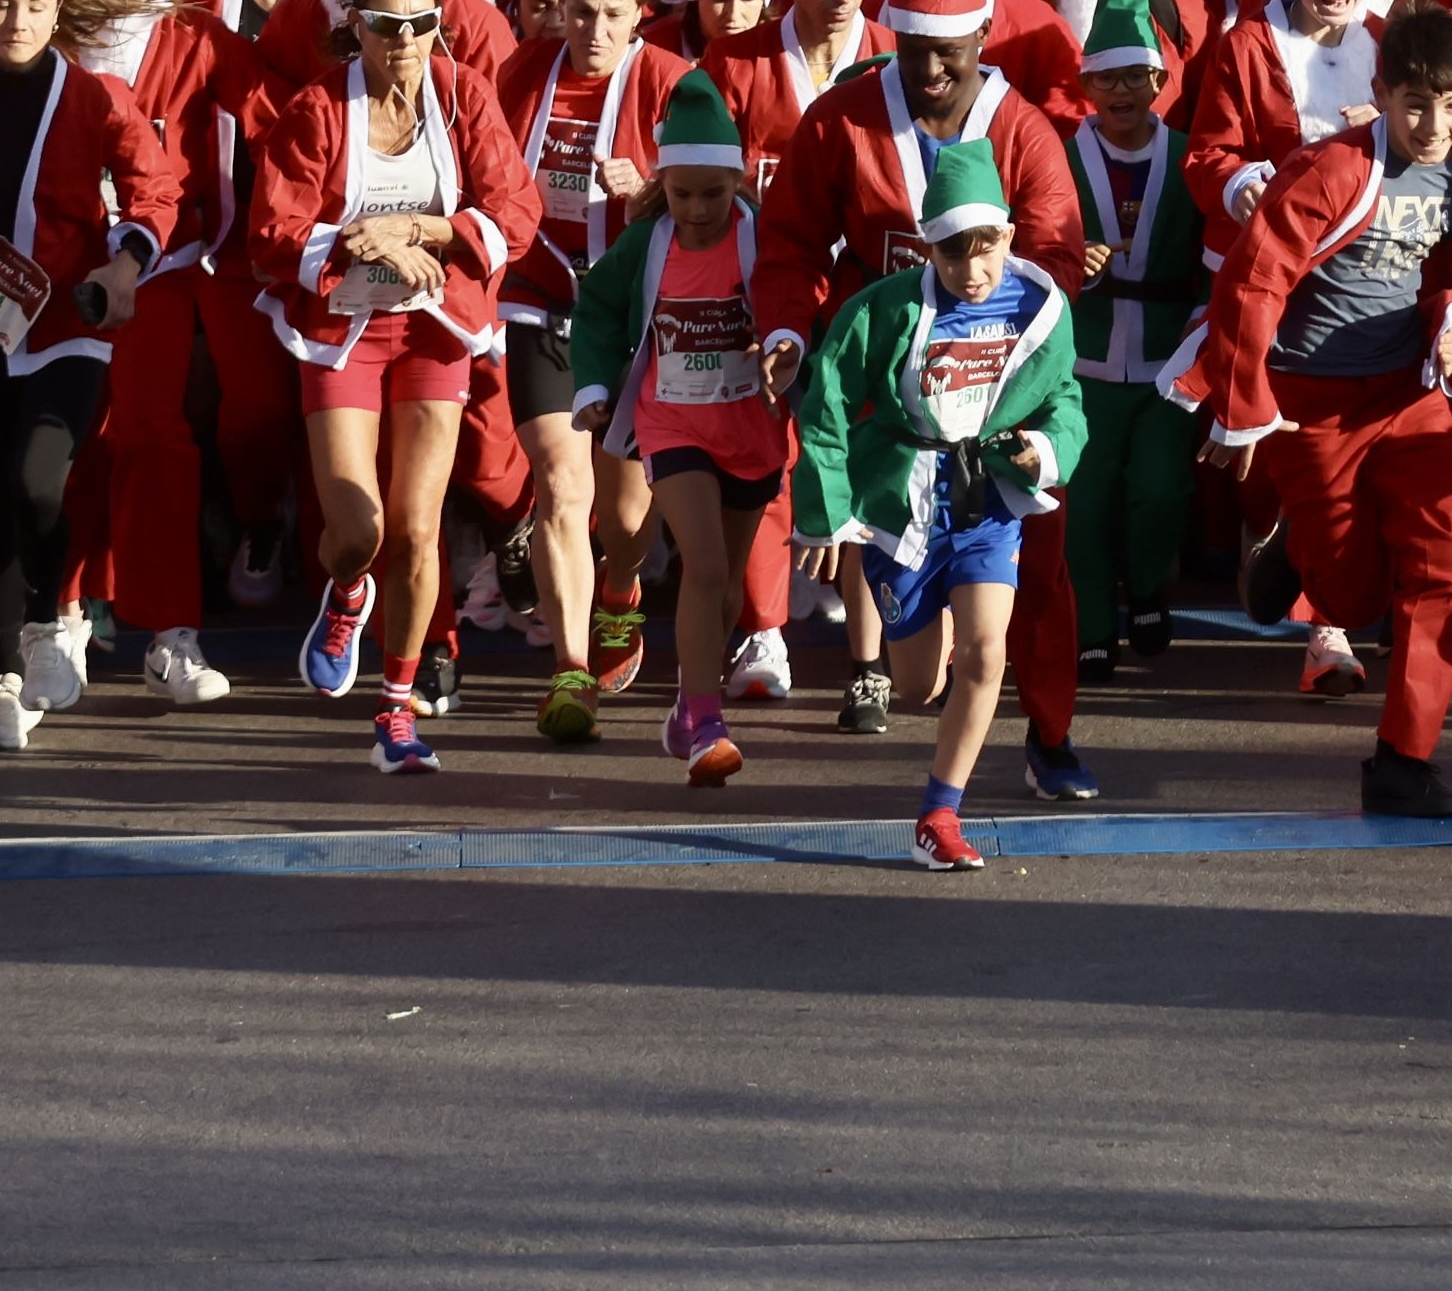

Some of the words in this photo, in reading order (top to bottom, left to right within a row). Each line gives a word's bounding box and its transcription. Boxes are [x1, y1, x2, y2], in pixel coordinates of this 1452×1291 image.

[553, 141, 584, 154] Pare
[549, 172, 588, 192] 3230
[367, 267, 404, 284] 306
[683, 321, 716, 333] Pare
[960, 358, 992, 370] Pare
